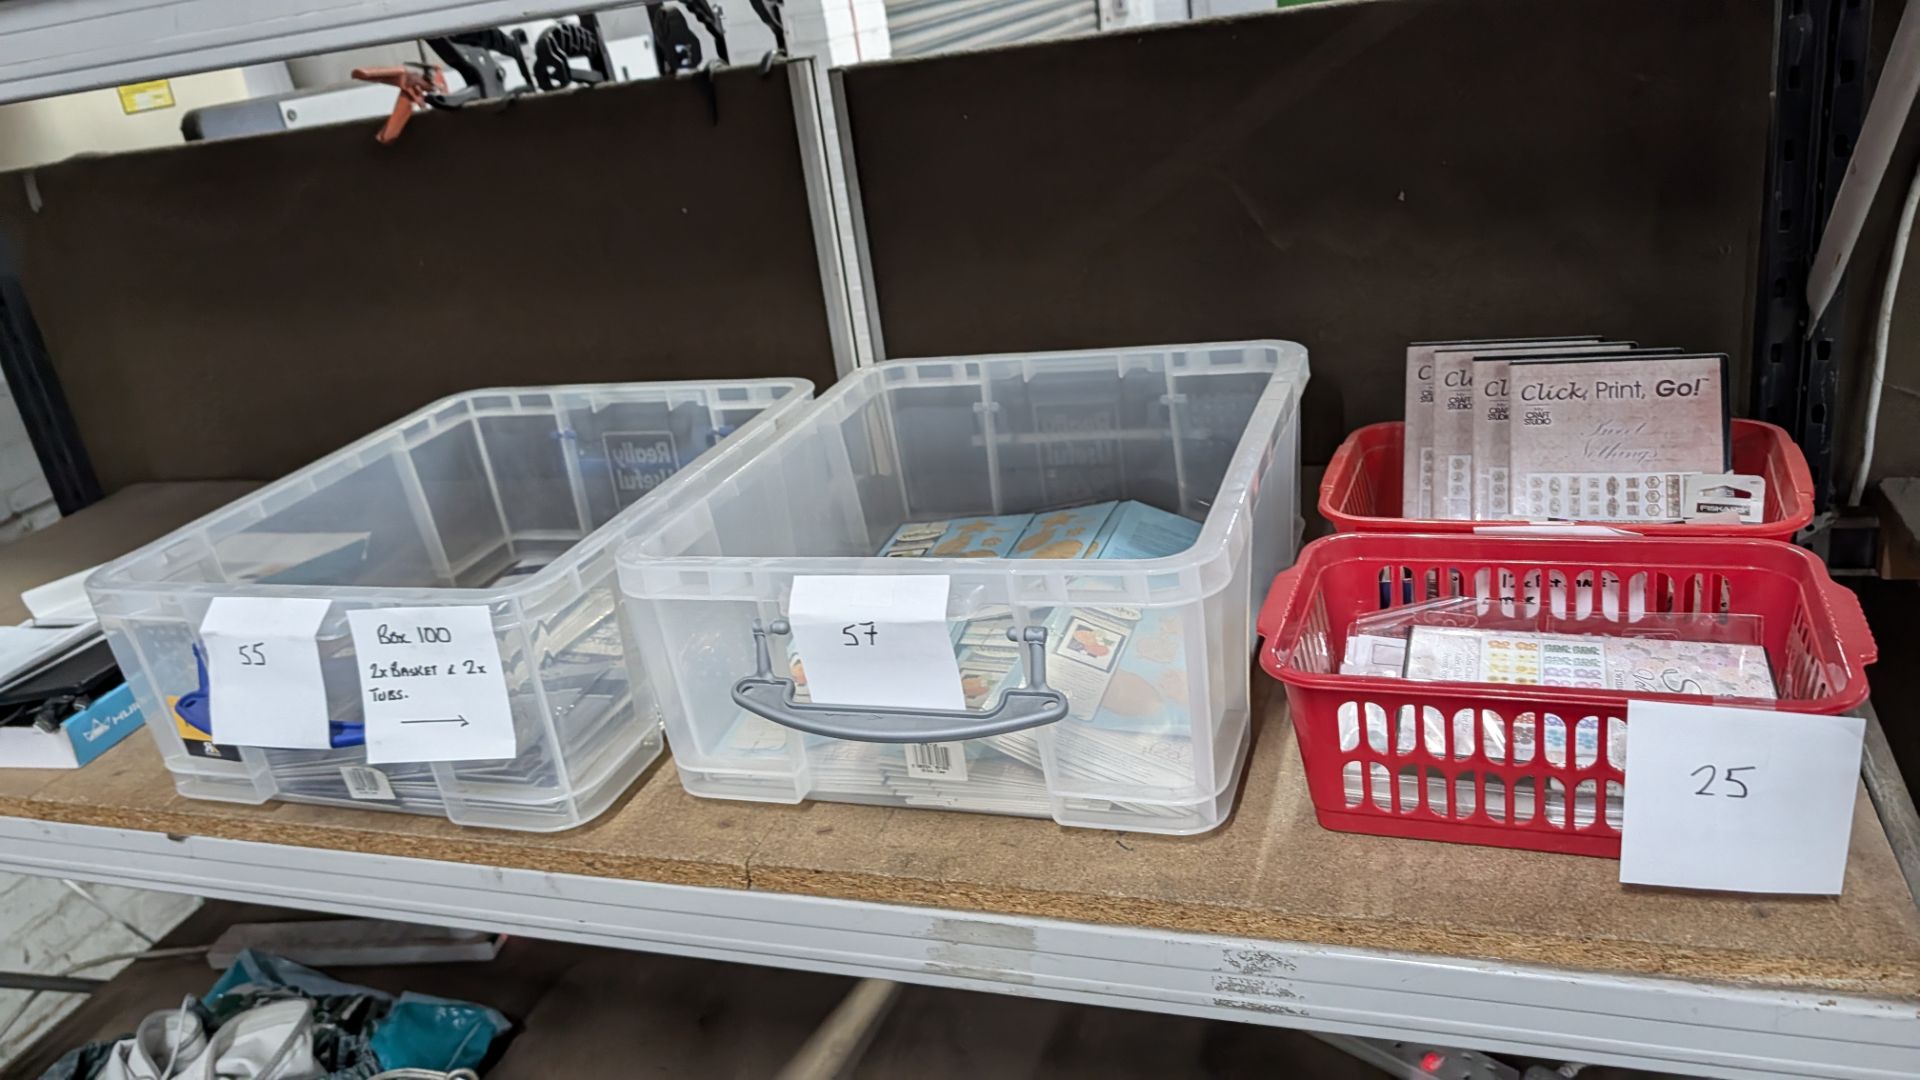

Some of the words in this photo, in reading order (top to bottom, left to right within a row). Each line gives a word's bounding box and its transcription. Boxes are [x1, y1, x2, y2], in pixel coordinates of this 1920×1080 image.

[1595, 381, 1646, 400] Print,
[1655, 378, 1701, 398] Go!
[1523, 418, 1552, 426] STUDIO
[1525, 411, 1551, 419] CRAFT
[418, 626, 452, 643] 100
[842, 621, 878, 646] 57
[238, 642, 266, 666] 55
[1690, 764, 1756, 799] 25
